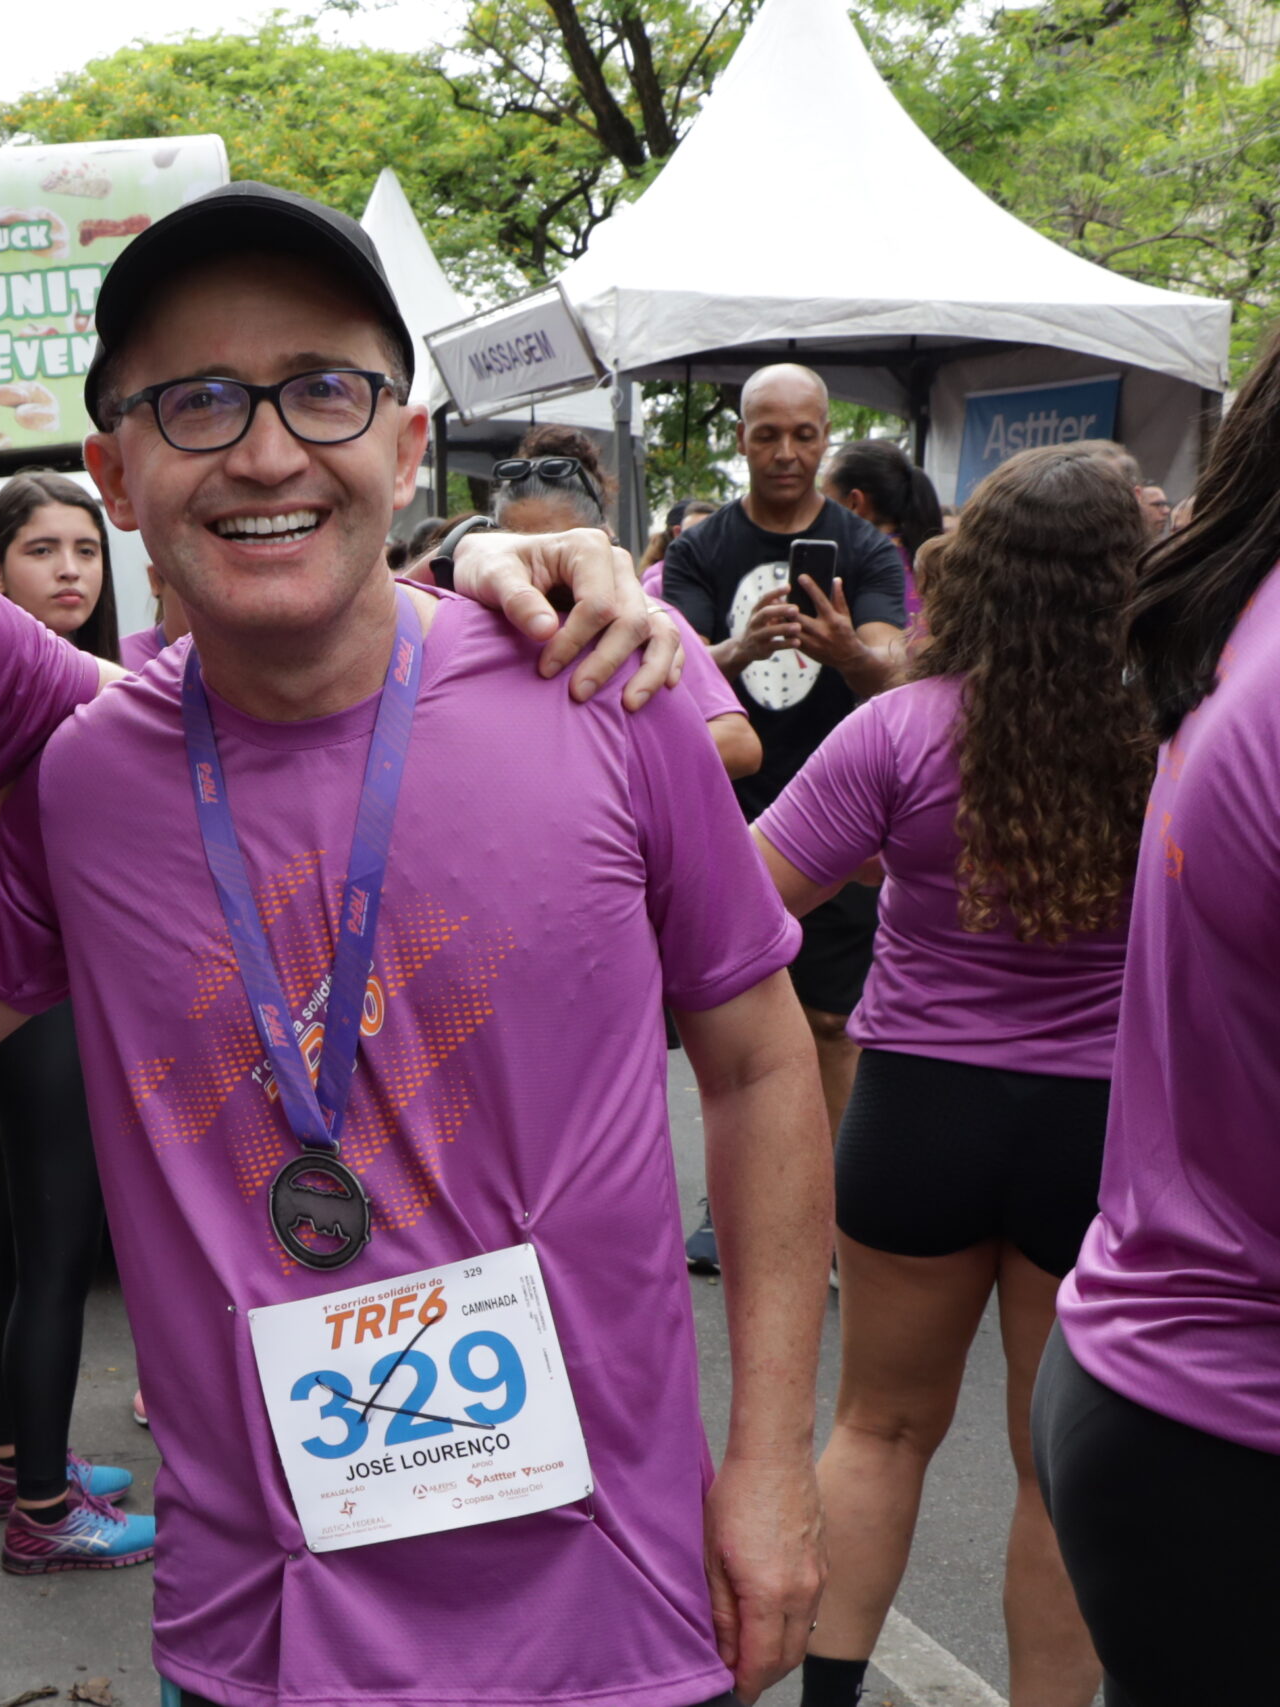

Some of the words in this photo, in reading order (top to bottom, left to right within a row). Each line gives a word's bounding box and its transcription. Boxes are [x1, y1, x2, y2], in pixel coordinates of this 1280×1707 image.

[469, 330, 556, 381] MASSAGEM
[983, 409, 1096, 459] Asttter
[463, 1267, 483, 1279] 329
[334, 1295, 375, 1311] corrida
[377, 1281, 426, 1300] solidária
[429, 1278, 443, 1288] do
[461, 1293, 518, 1316] CAMINHADA
[325, 1286, 448, 1350] TRF6
[290, 1330, 527, 1460] 329
[345, 1453, 396, 1481] JOSÉ
[400, 1433, 510, 1470] LOURENÇO
[483, 1471, 517, 1484] Asttter
[532, 1461, 564, 1474] SICOOB
[464, 1494, 494, 1506] copasa
